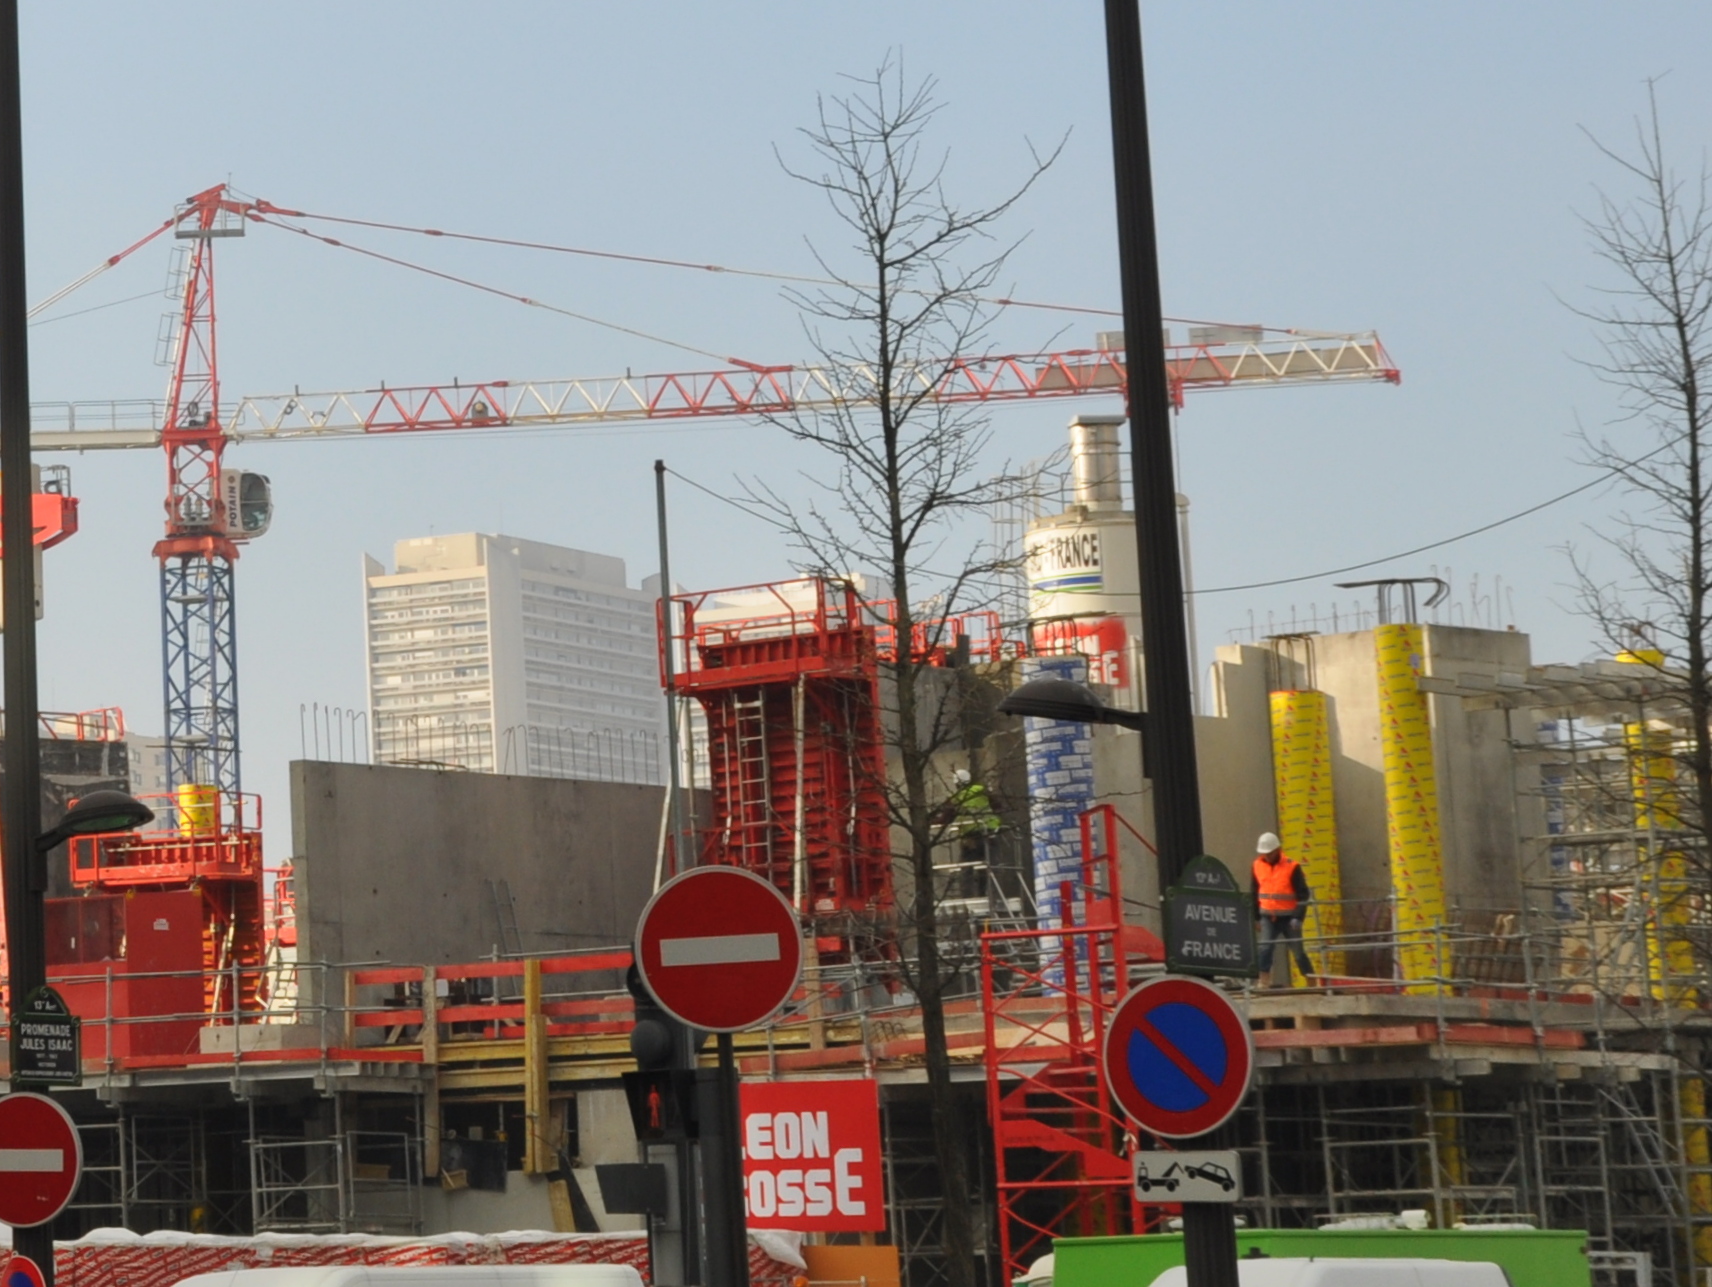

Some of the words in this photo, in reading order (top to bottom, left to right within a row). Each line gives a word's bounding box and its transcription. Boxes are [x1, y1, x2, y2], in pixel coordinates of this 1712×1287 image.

[228, 486, 237, 528] POTAIN
[1185, 904, 1238, 923] AVENUE
[1183, 940, 1242, 960] FRANCE
[20, 1024, 71, 1037] PROMENADE
[20, 1038, 45, 1050] JULES
[48, 1039, 73, 1051] ISAAC
[742, 1111, 830, 1160] EON
[744, 1148, 866, 1217] OSSE
